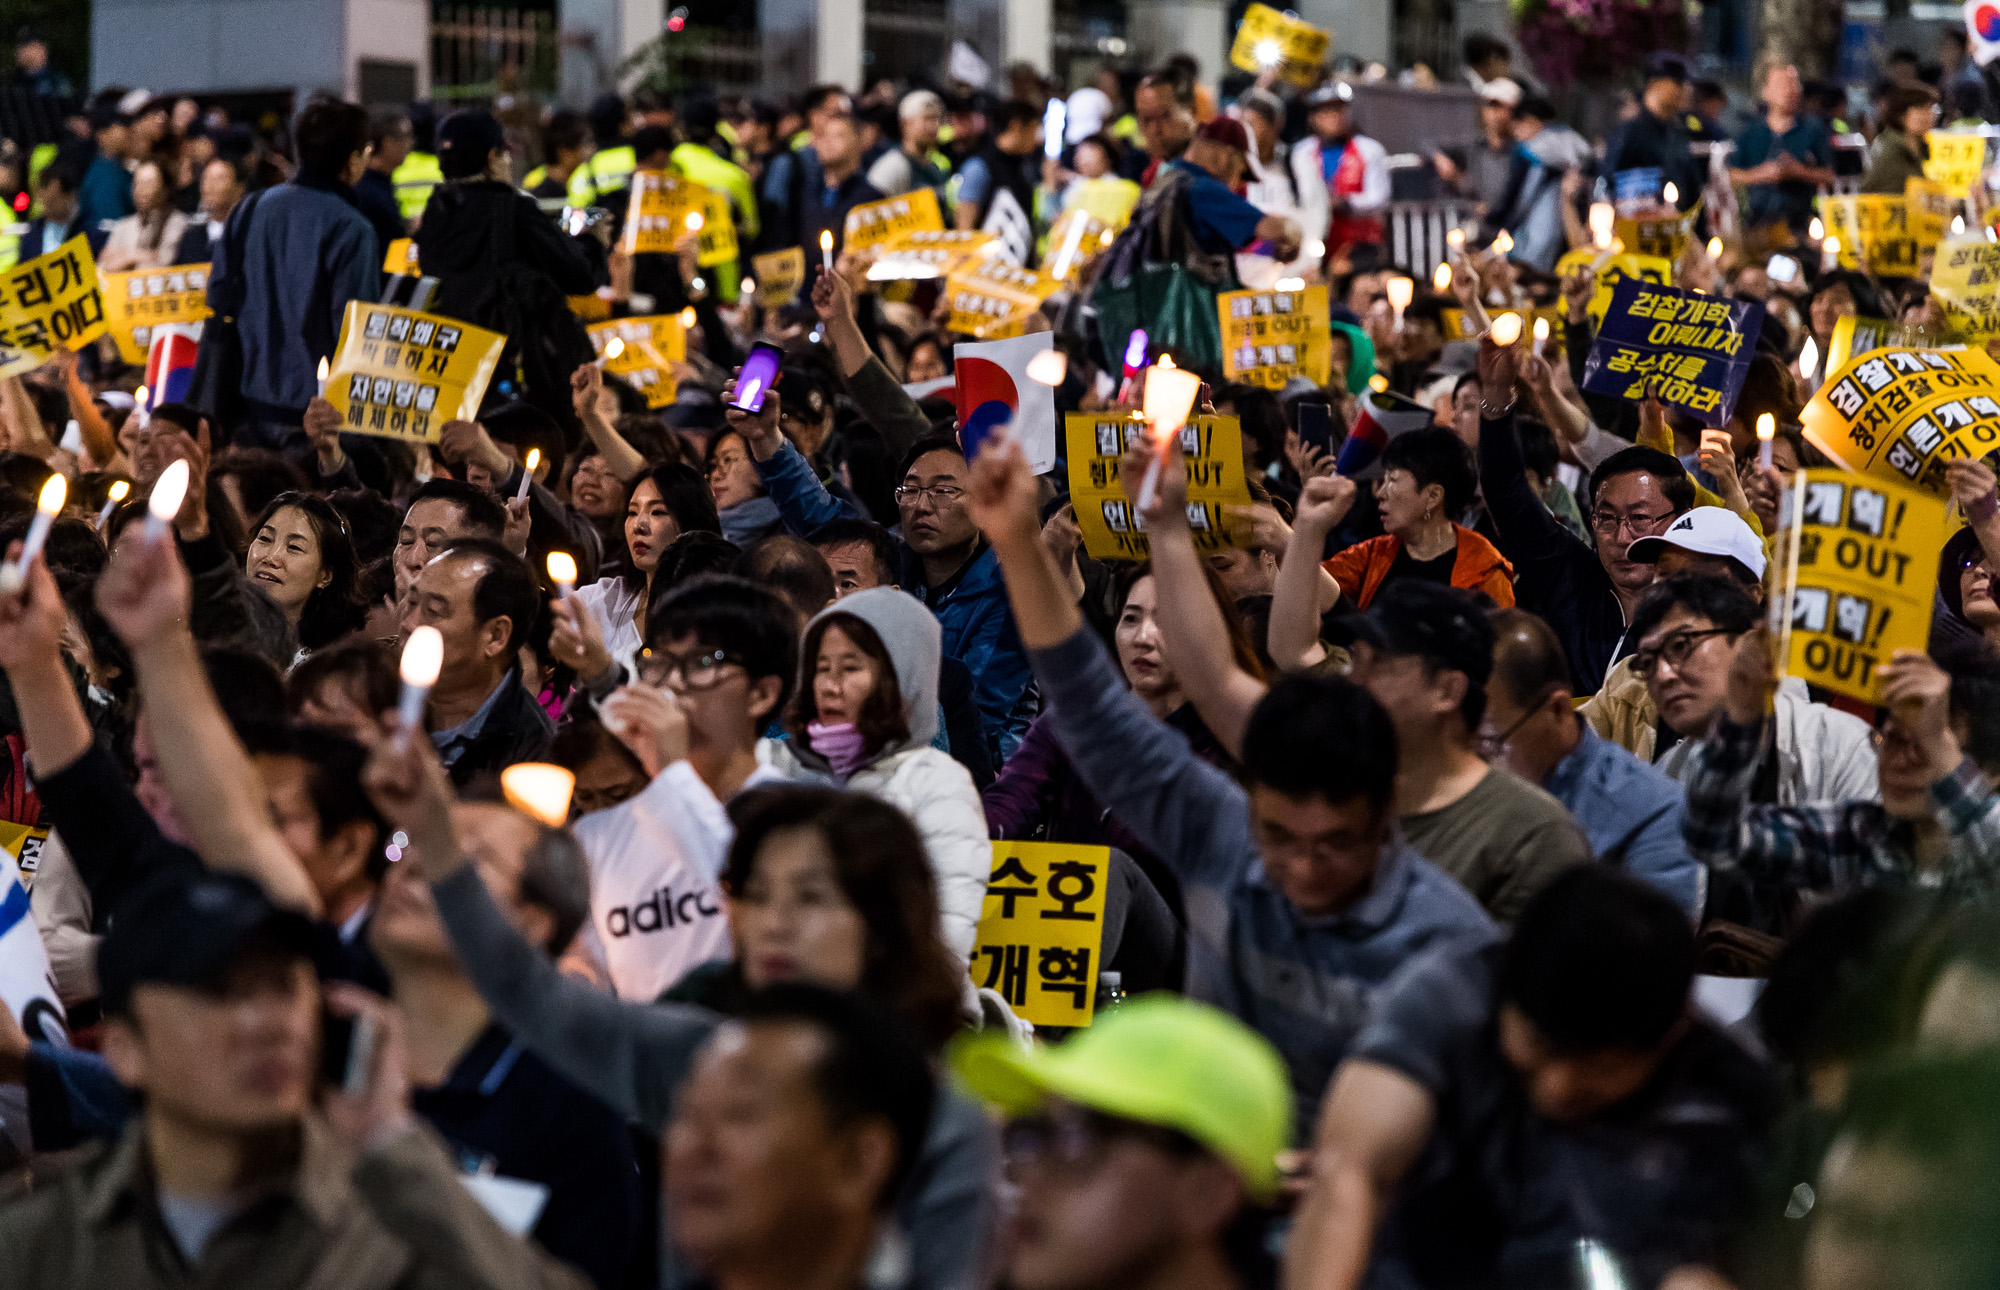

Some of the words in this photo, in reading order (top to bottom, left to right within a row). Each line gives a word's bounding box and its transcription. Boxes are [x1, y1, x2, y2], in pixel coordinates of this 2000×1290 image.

[0, 250, 82, 307] 리가
[1627, 291, 1732, 328] 검찰개혁
[1606, 348, 1707, 381] 공수처를
[1828, 350, 1965, 422] 검찰개혁!
[1848, 376, 1935, 450] 정치검찰
[1779, 482, 1907, 541] 개혁!
[1835, 536, 1912, 585] OUT
[1770, 587, 1892, 650] 개혁!
[1804, 640, 1879, 687] OUT
[986, 857, 1097, 922] 수호
[968, 944, 1091, 1010] 개혁
